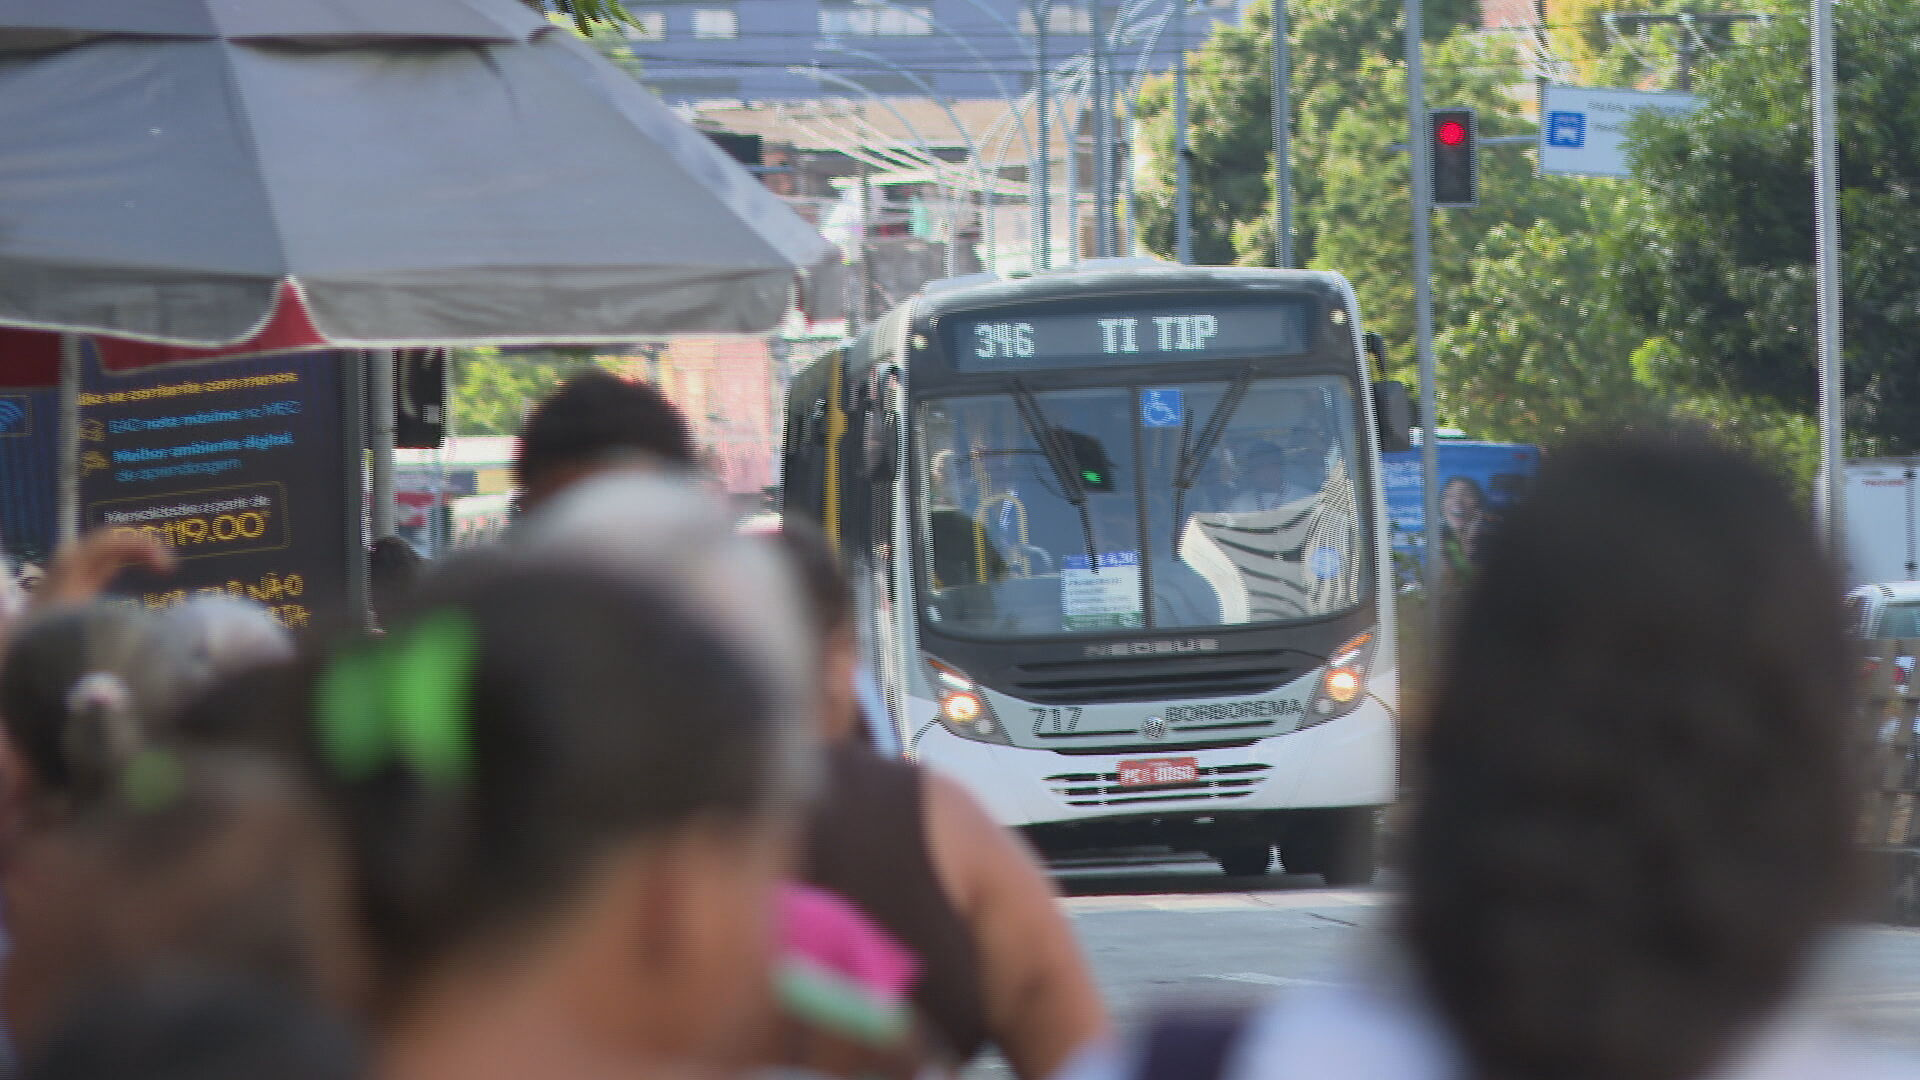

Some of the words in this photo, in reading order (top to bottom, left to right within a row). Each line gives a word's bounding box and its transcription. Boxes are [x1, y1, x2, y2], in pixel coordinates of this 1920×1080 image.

[973, 322, 1036, 359] 346
[1097, 317, 1140, 354] TI
[1152, 314, 1218, 352] TIP
[104, 392, 128, 404] se
[127, 380, 203, 401] contente
[202, 376, 241, 393] com
[240, 371, 299, 389] menos
[109, 418, 144, 434] EAD
[143, 414, 181, 430] nota
[180, 408, 241, 427] máxima
[241, 409, 264, 421] no
[263, 400, 302, 417] MEC
[113, 446, 170, 464] Melhor
[169, 438, 241, 457] ambiente
[241, 431, 295, 451] digital
[115, 470, 138, 483] de
[104, 503, 201, 523] Mensalidades
[199, 503, 213, 514] a
[211, 496, 251, 515] partir
[250, 494, 272, 508] de
[1105, 552, 1138, 566] 4,30
[246, 572, 304, 601] NÃO
[1084, 638, 1219, 657] NEOBUS
[1029, 706, 1083, 732] 717
[1165, 698, 1304, 723] BORBOREMA
